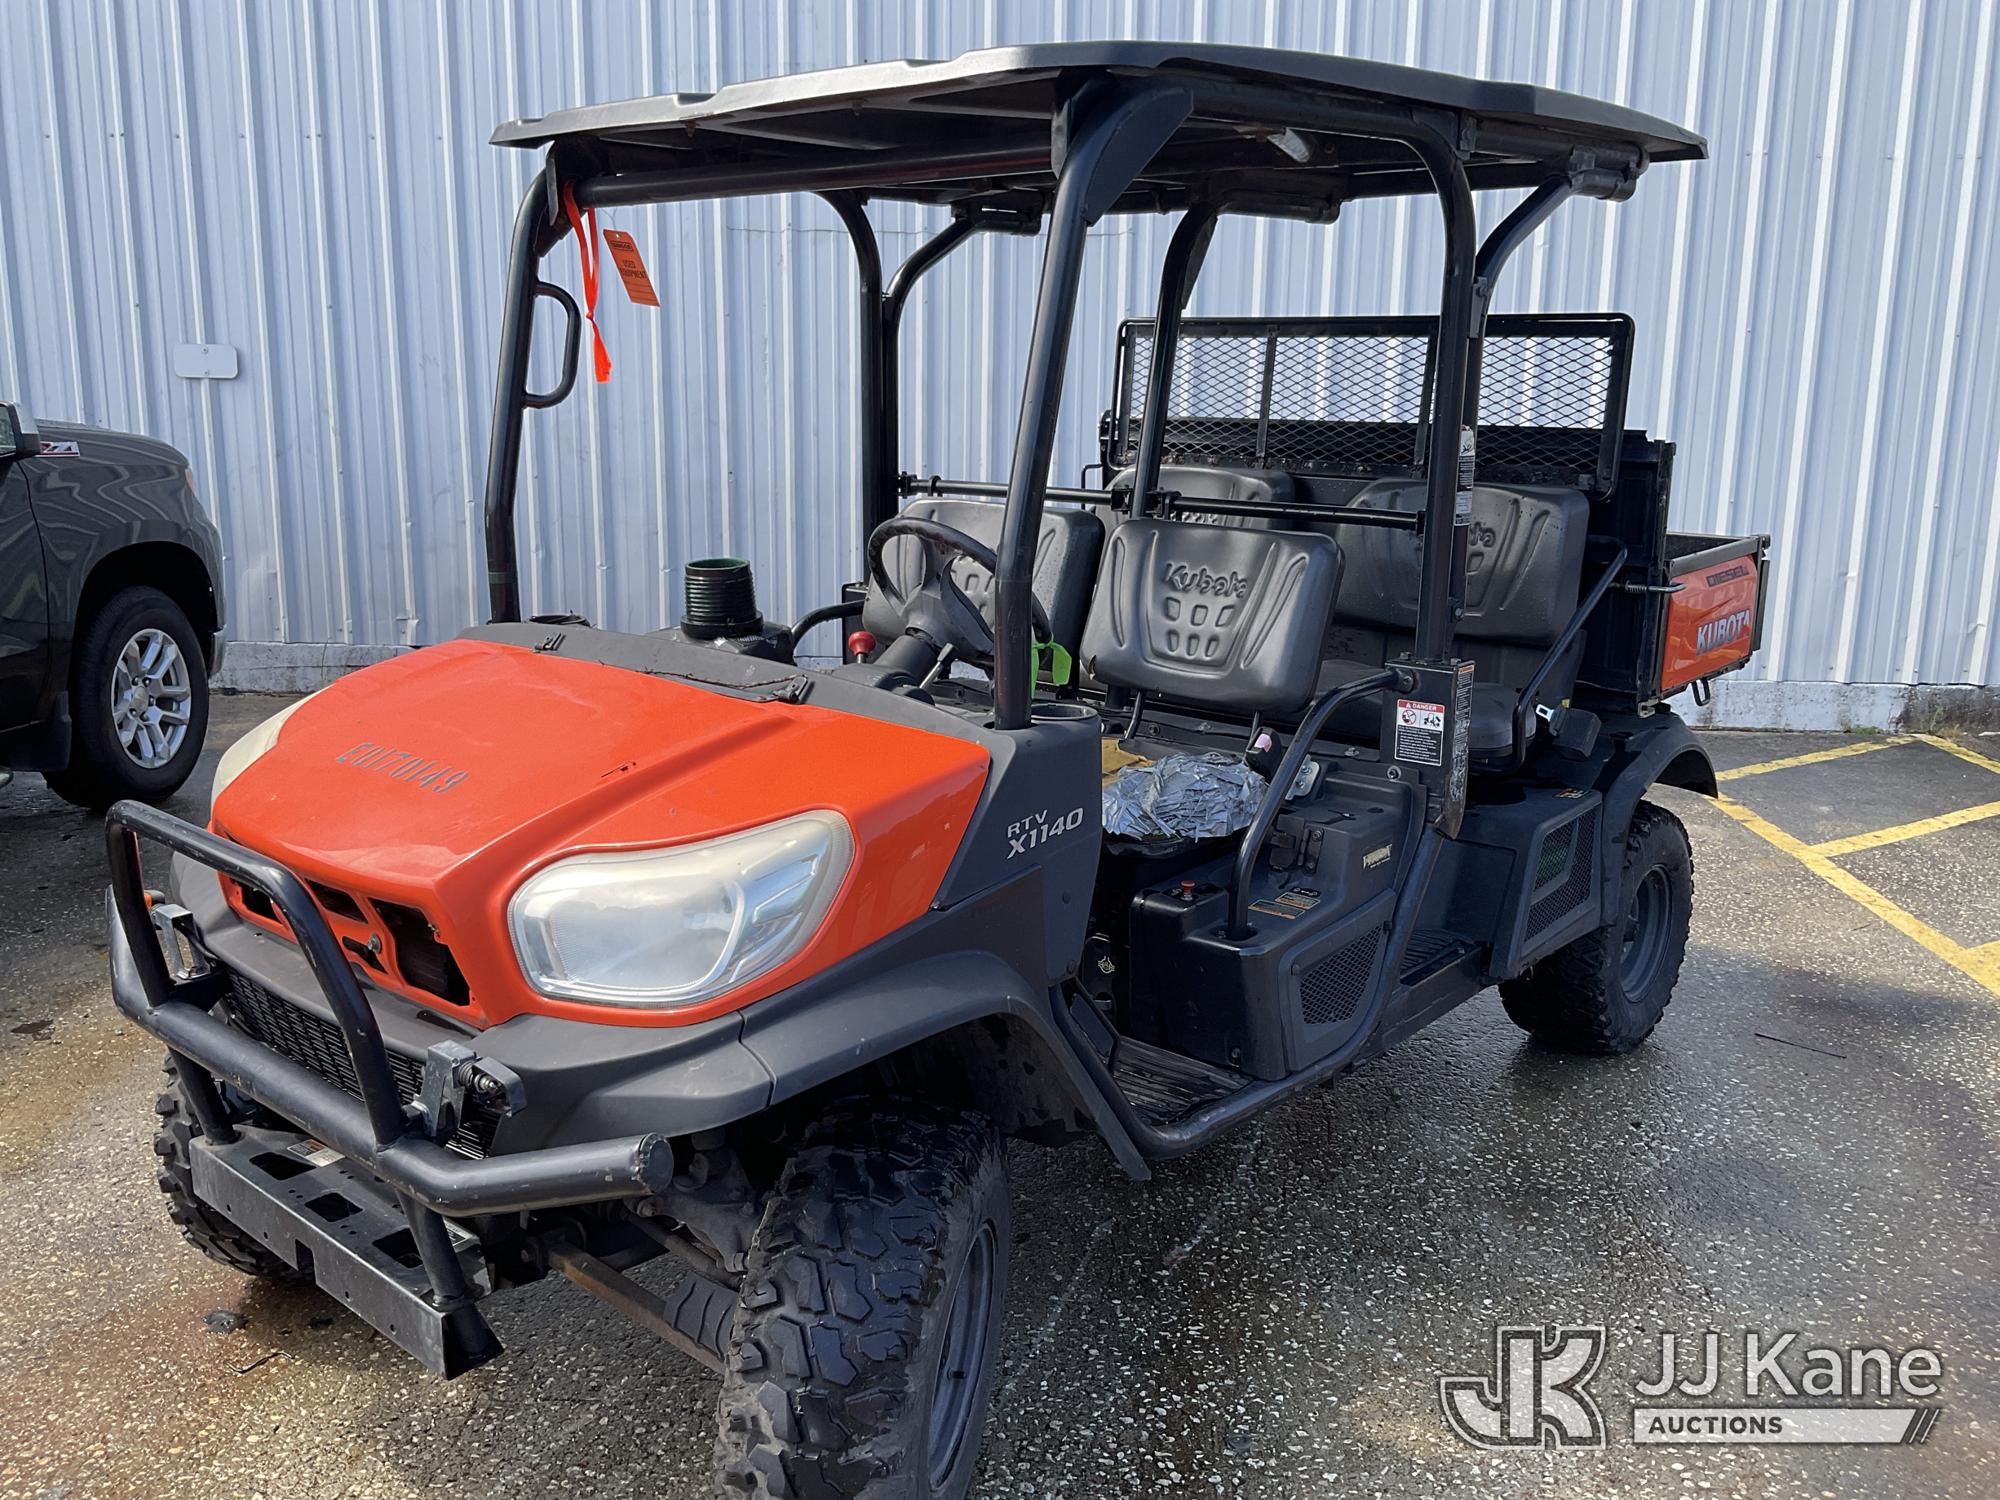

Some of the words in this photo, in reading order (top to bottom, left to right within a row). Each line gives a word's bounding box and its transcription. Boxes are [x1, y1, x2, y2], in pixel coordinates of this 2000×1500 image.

[1163, 562, 1249, 598] Kubota
[1696, 610, 1750, 656] KUBOTA
[1412, 703, 1437, 711] DANGER
[1007, 809, 1047, 838] RTV
[1007, 807, 1084, 859] X1140
